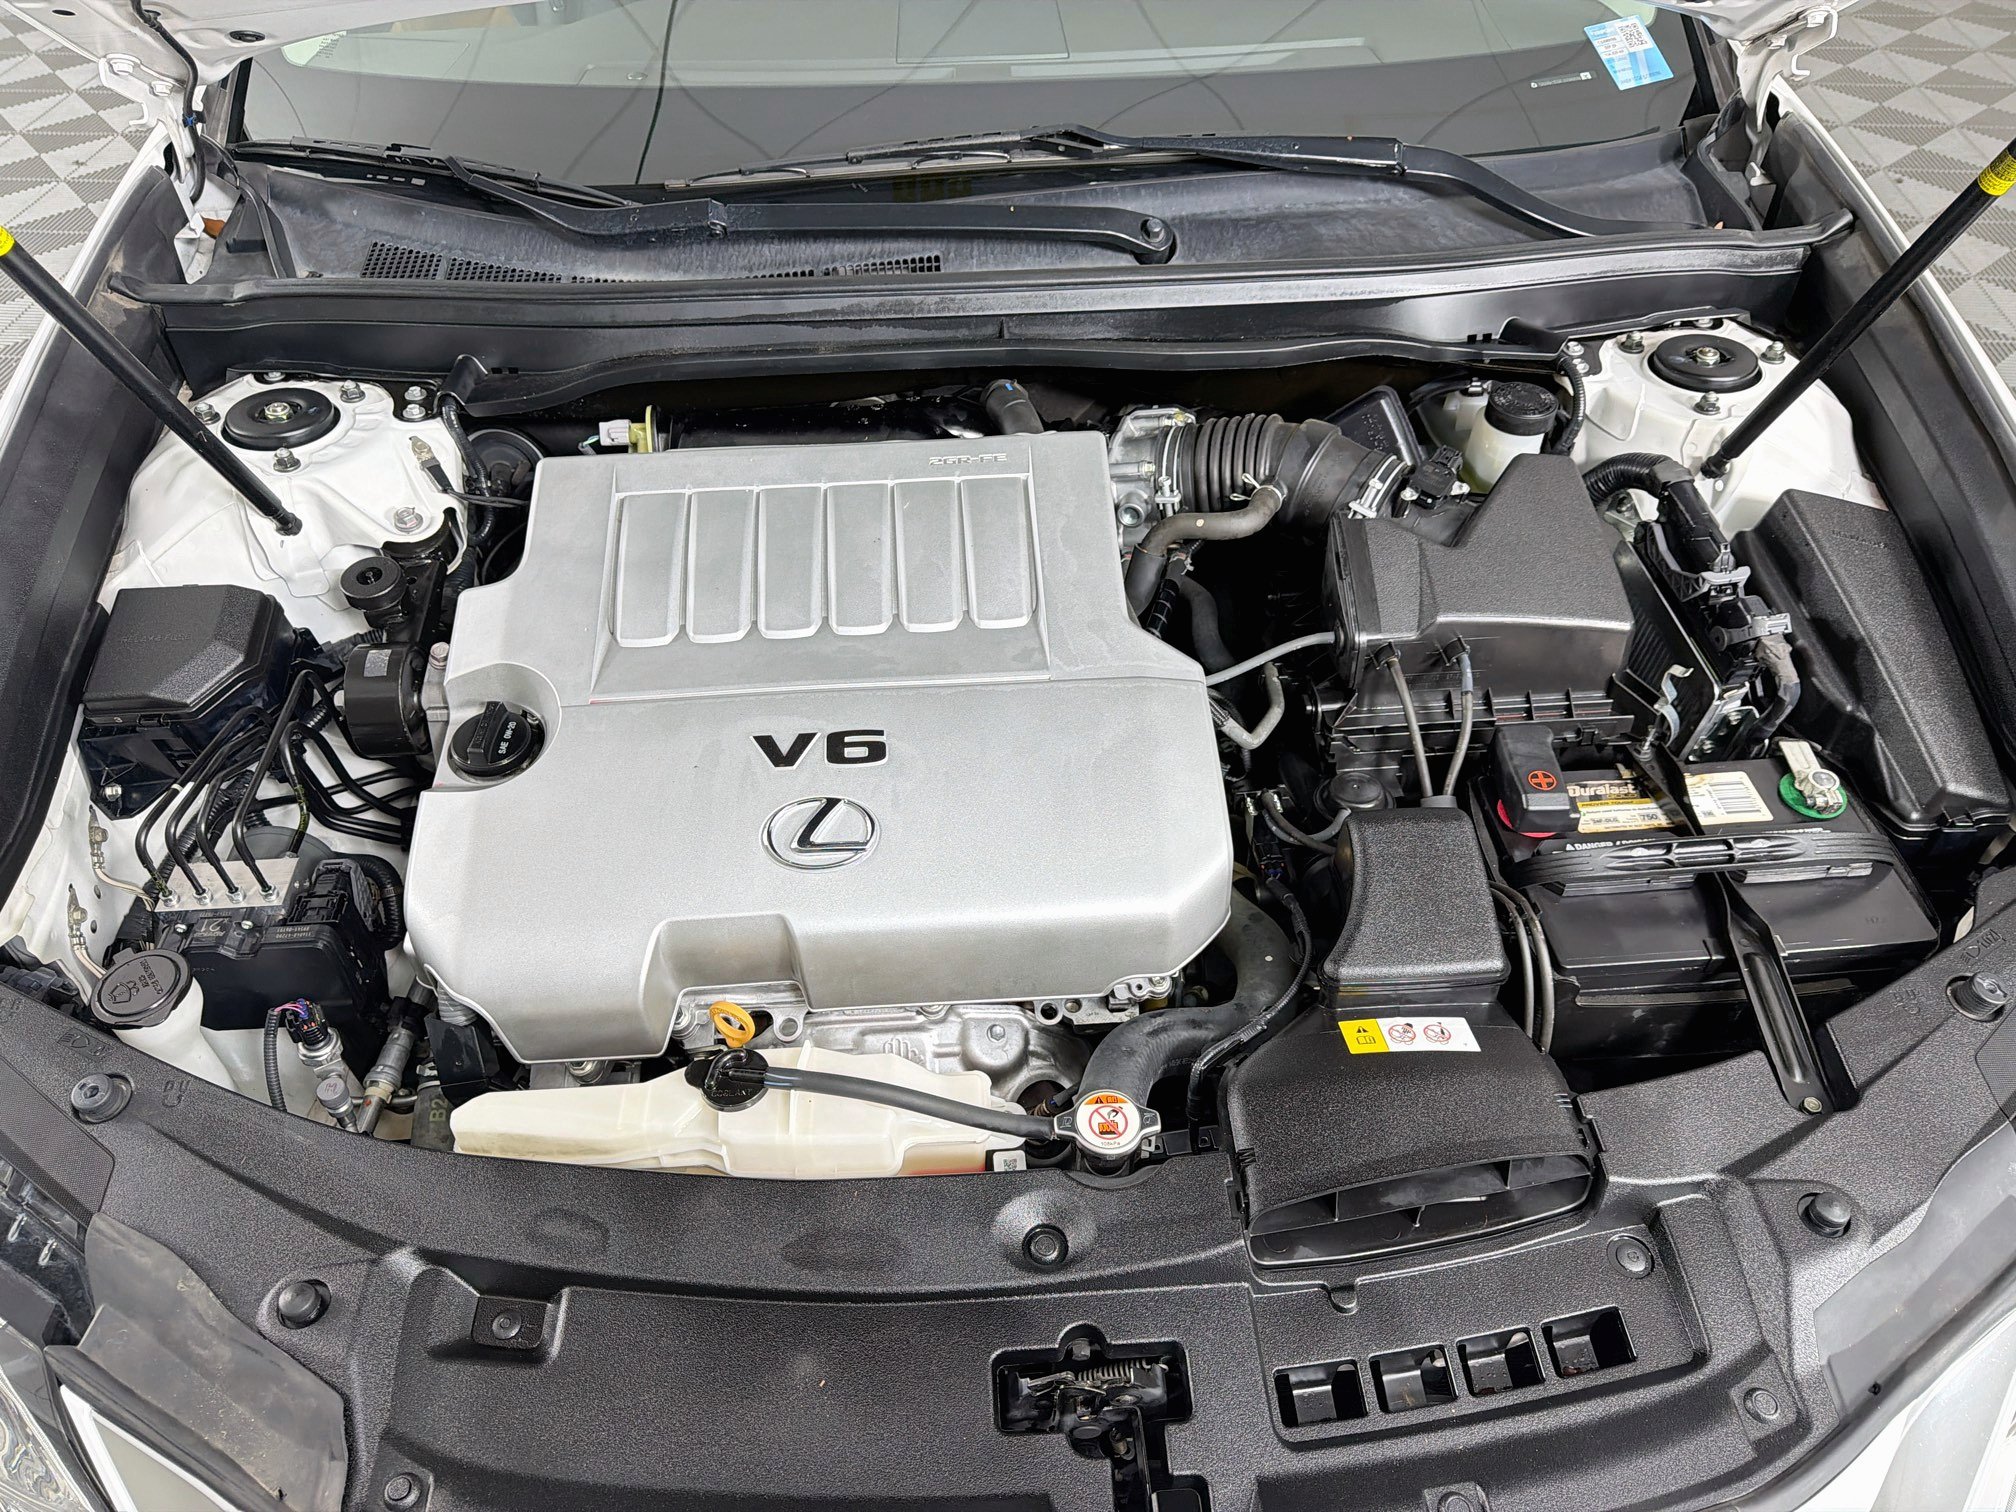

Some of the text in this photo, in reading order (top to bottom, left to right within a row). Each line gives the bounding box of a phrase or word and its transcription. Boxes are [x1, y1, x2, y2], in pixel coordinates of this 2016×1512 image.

[928, 452, 1008, 466] 2GR-FE
[498, 721, 517, 755] SAE 0W-20
[749, 729, 889, 770] V6
[1566, 783, 1637, 797] Duralast
[1639, 813, 1659, 821] 750
[711, 1088, 753, 1098] COOLANT
[429, 1098, 449, 1122] B2
